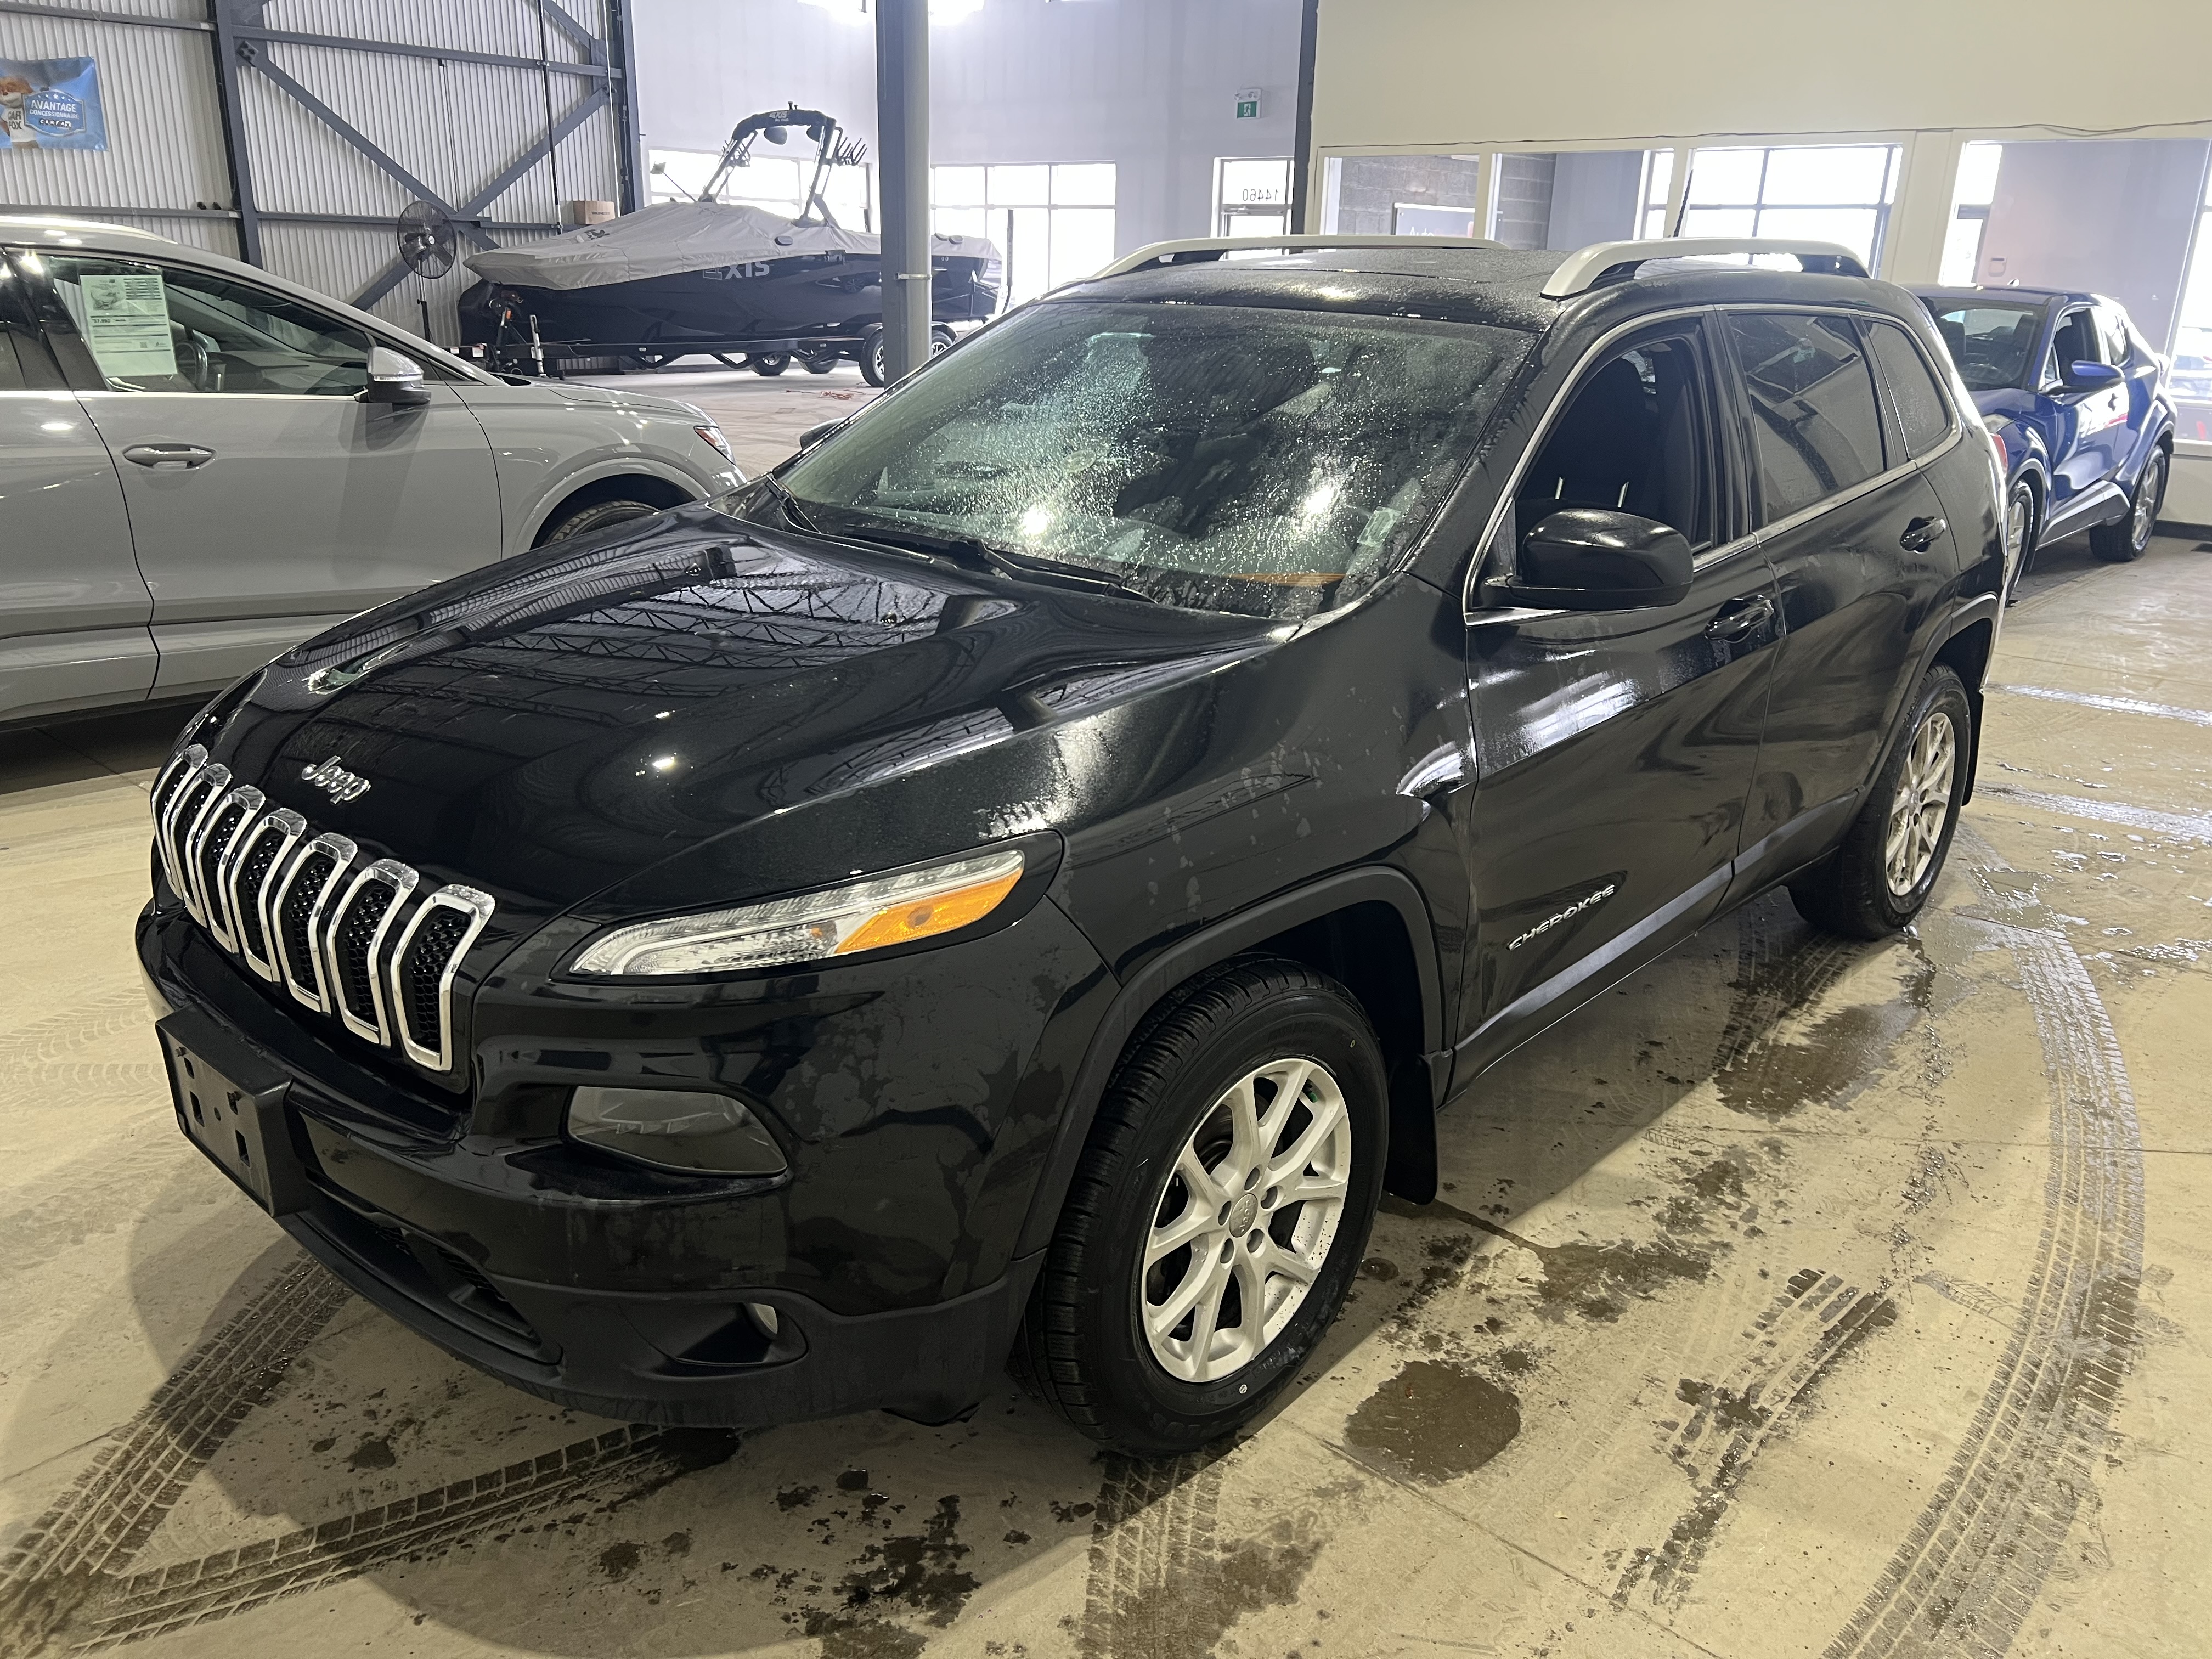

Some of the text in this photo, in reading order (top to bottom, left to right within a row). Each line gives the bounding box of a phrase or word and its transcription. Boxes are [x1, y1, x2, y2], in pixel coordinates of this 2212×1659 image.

[31, 100, 77, 112] AVANTAGE
[8, 111, 21, 120] CAR
[29, 109, 80, 119] CONCESSIONNAIRE
[9, 121, 22, 129] FOX
[40, 119, 72, 127] CARFAX
[301, 755, 371, 805] Jeep
[1508, 884, 1615, 951] CHEROKEE
